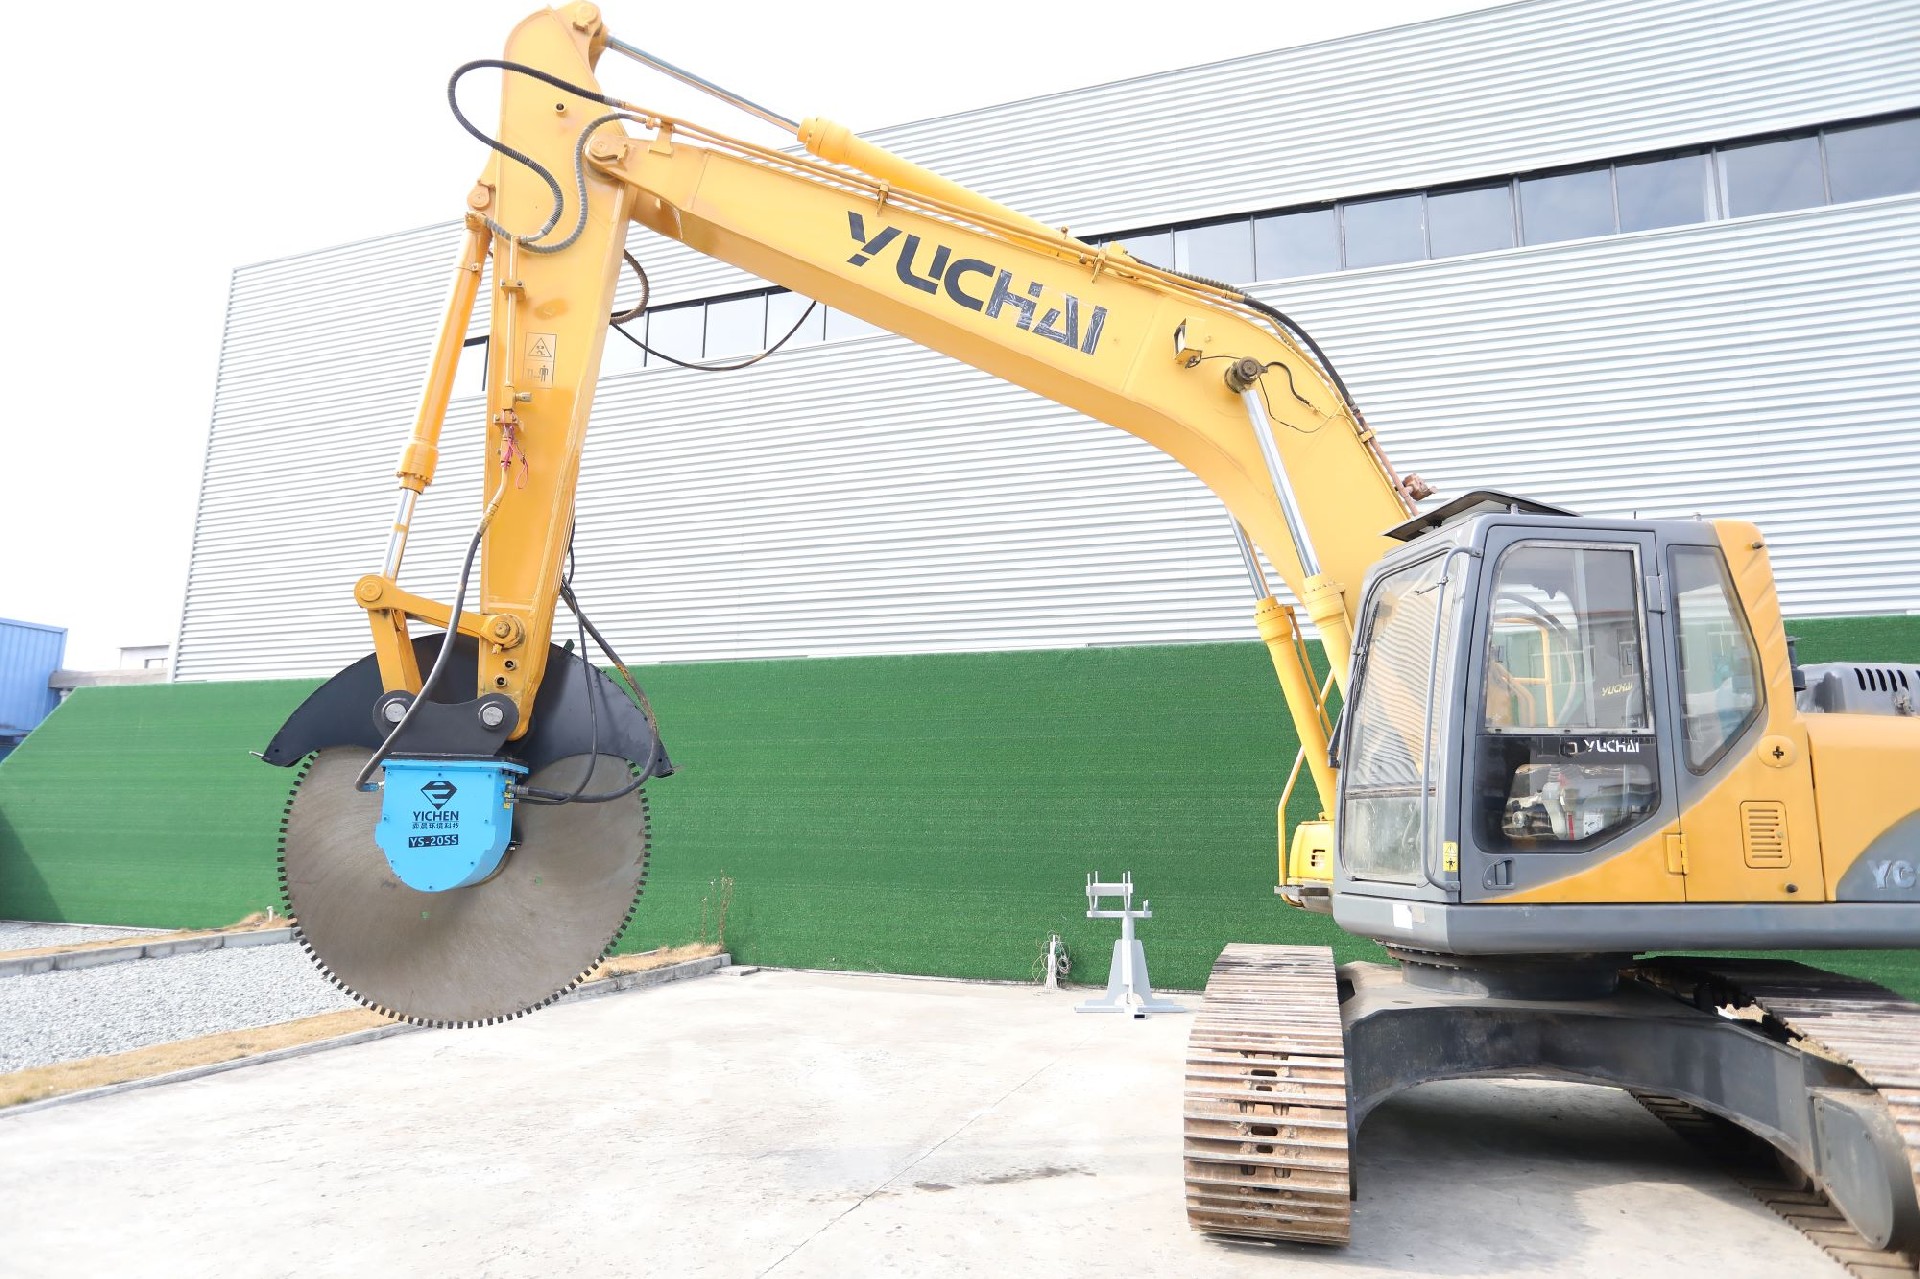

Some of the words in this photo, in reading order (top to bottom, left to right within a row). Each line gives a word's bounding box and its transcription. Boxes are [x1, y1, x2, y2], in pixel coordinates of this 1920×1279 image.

[847, 210, 1108, 356] YUCHAI
[1601, 681, 1634, 697] YUCHAI
[1583, 739, 1640, 753] YUCHAI
[413, 810, 459, 821] YICHEN
[409, 835, 458, 848] YS-20SS
[1867, 859, 1920, 891] YC
